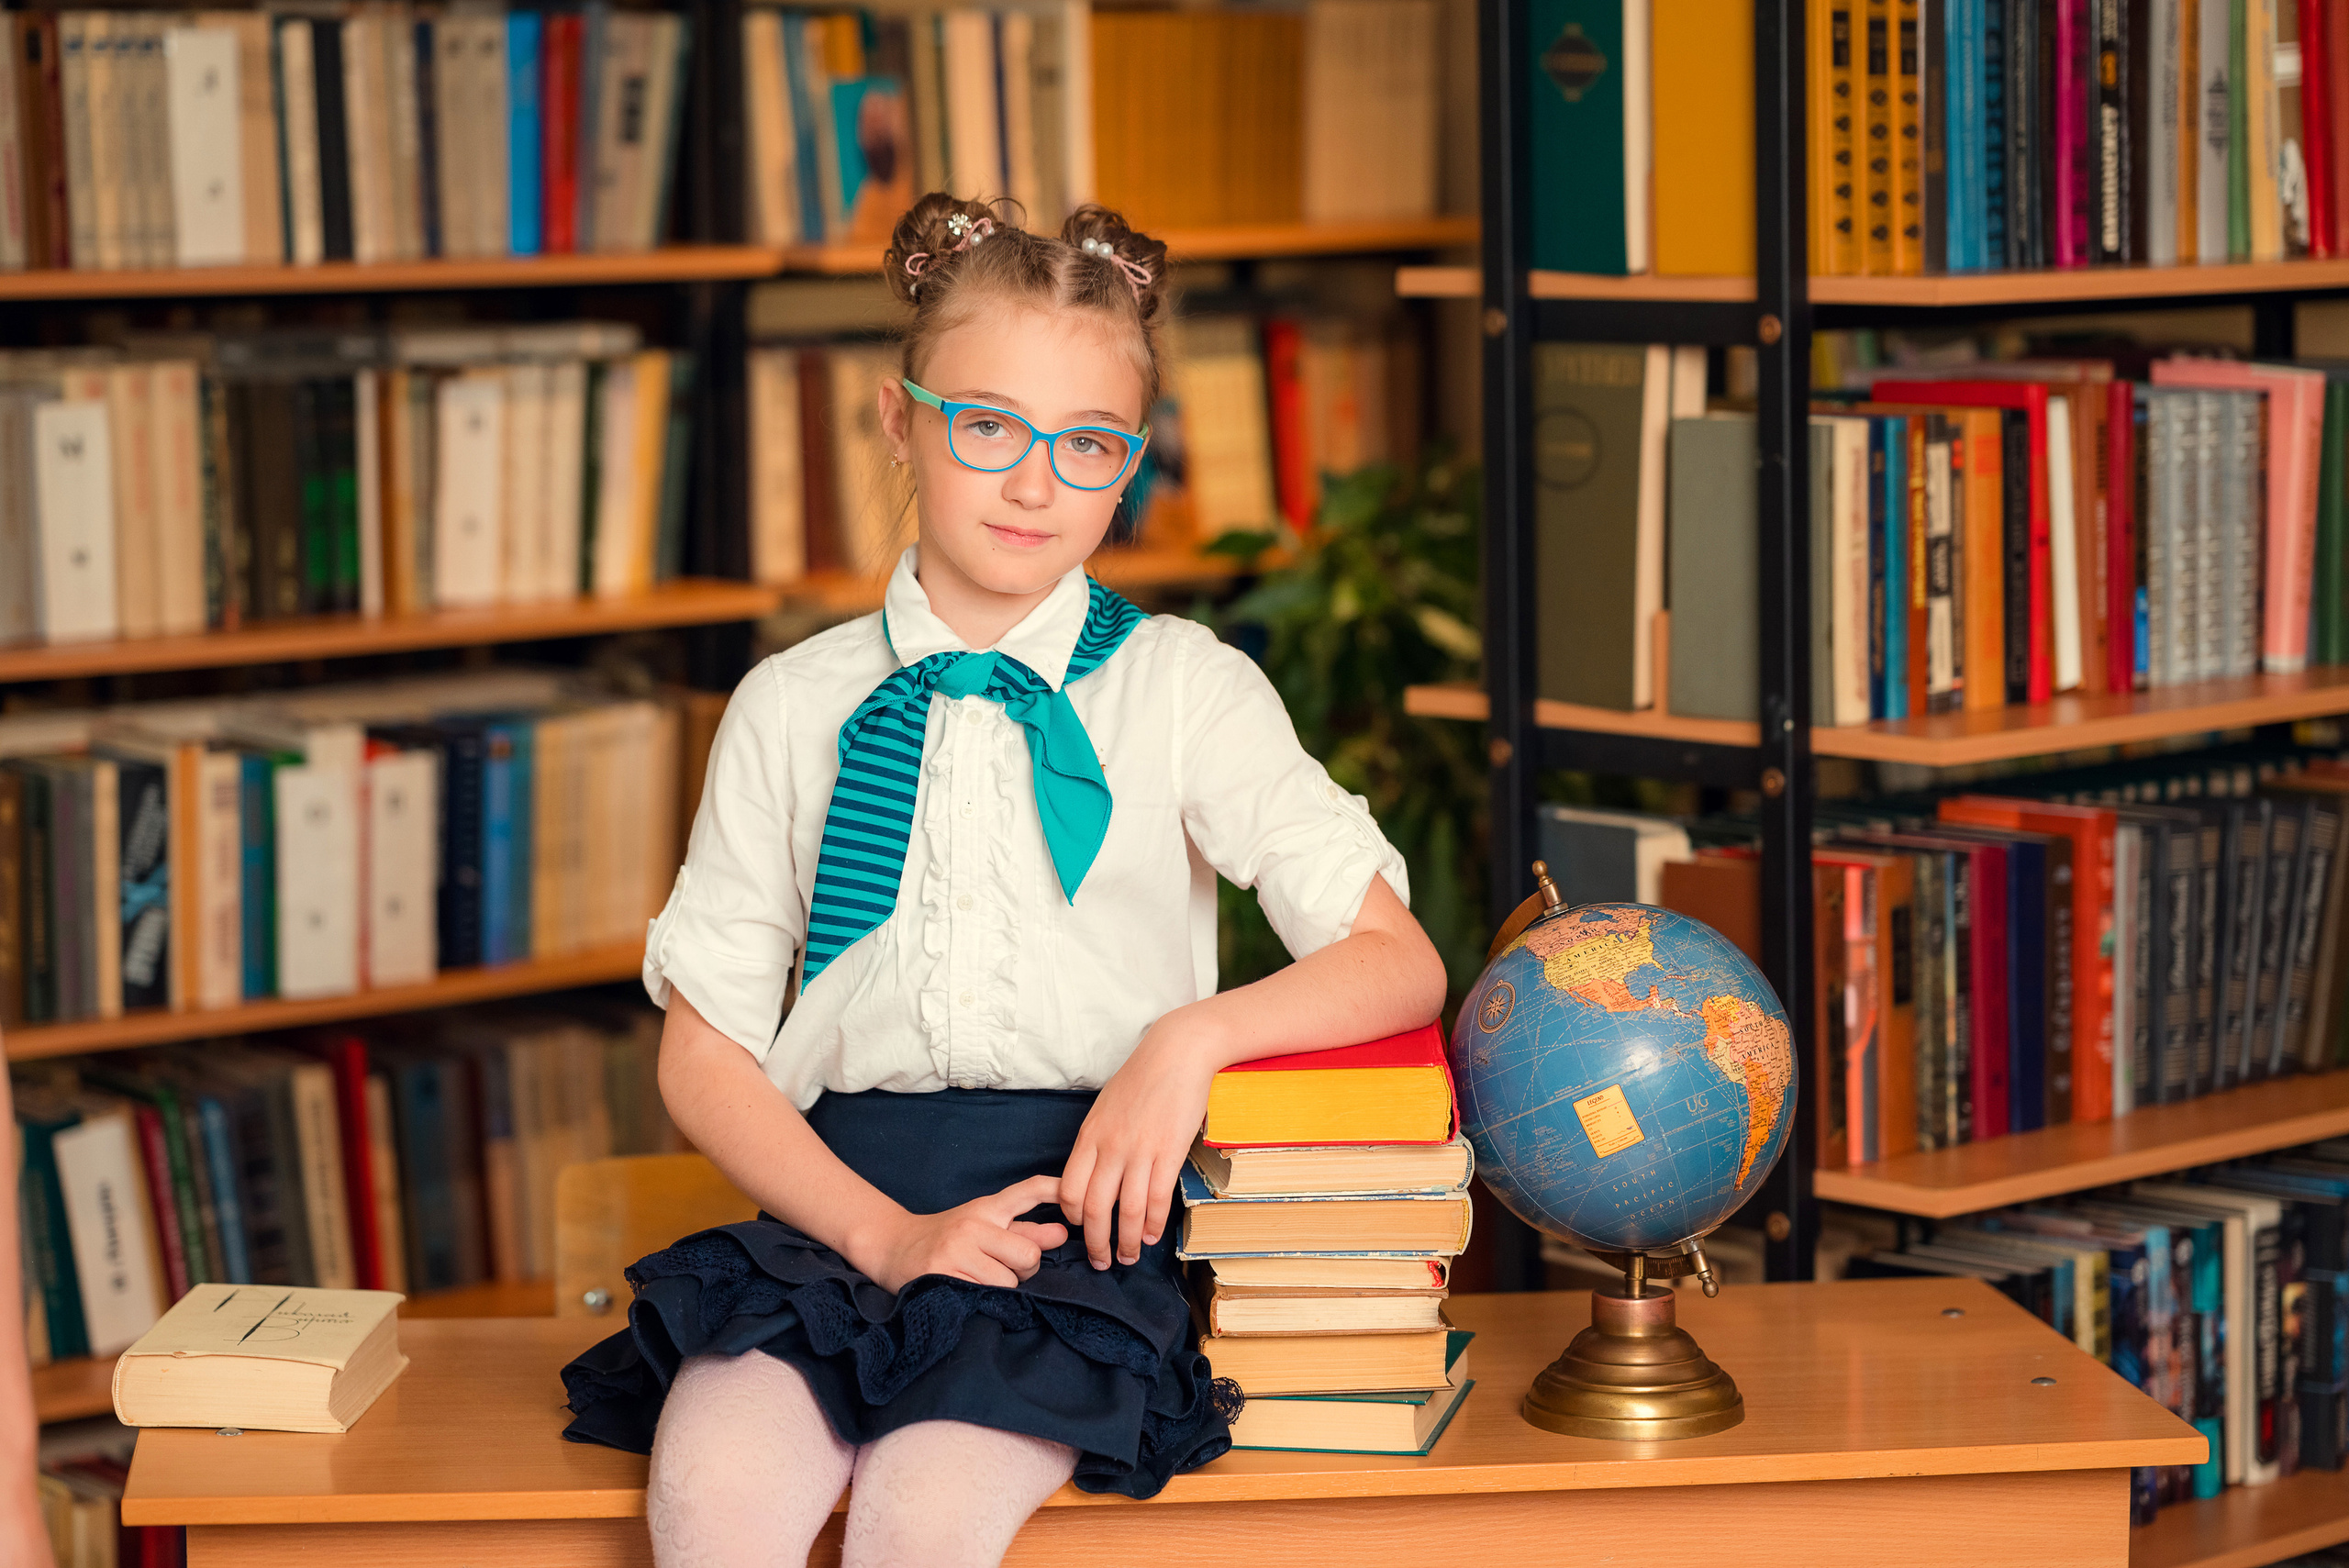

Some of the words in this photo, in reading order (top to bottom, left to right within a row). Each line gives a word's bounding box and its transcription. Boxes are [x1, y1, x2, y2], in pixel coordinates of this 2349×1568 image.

[1567, 939, 1619, 962] AMERICA
[1740, 1020, 1764, 1033] SOUTH
[1742, 1042, 1775, 1060] AMERICA
[1586, 1095, 1605, 1106] LEGEND
[1686, 1093, 1709, 1113] UG
[1612, 1169, 1656, 1193] SOUTH
[1615, 1181, 1675, 1209] PACIFIC
[1630, 1198, 1675, 1220] OCEAN
